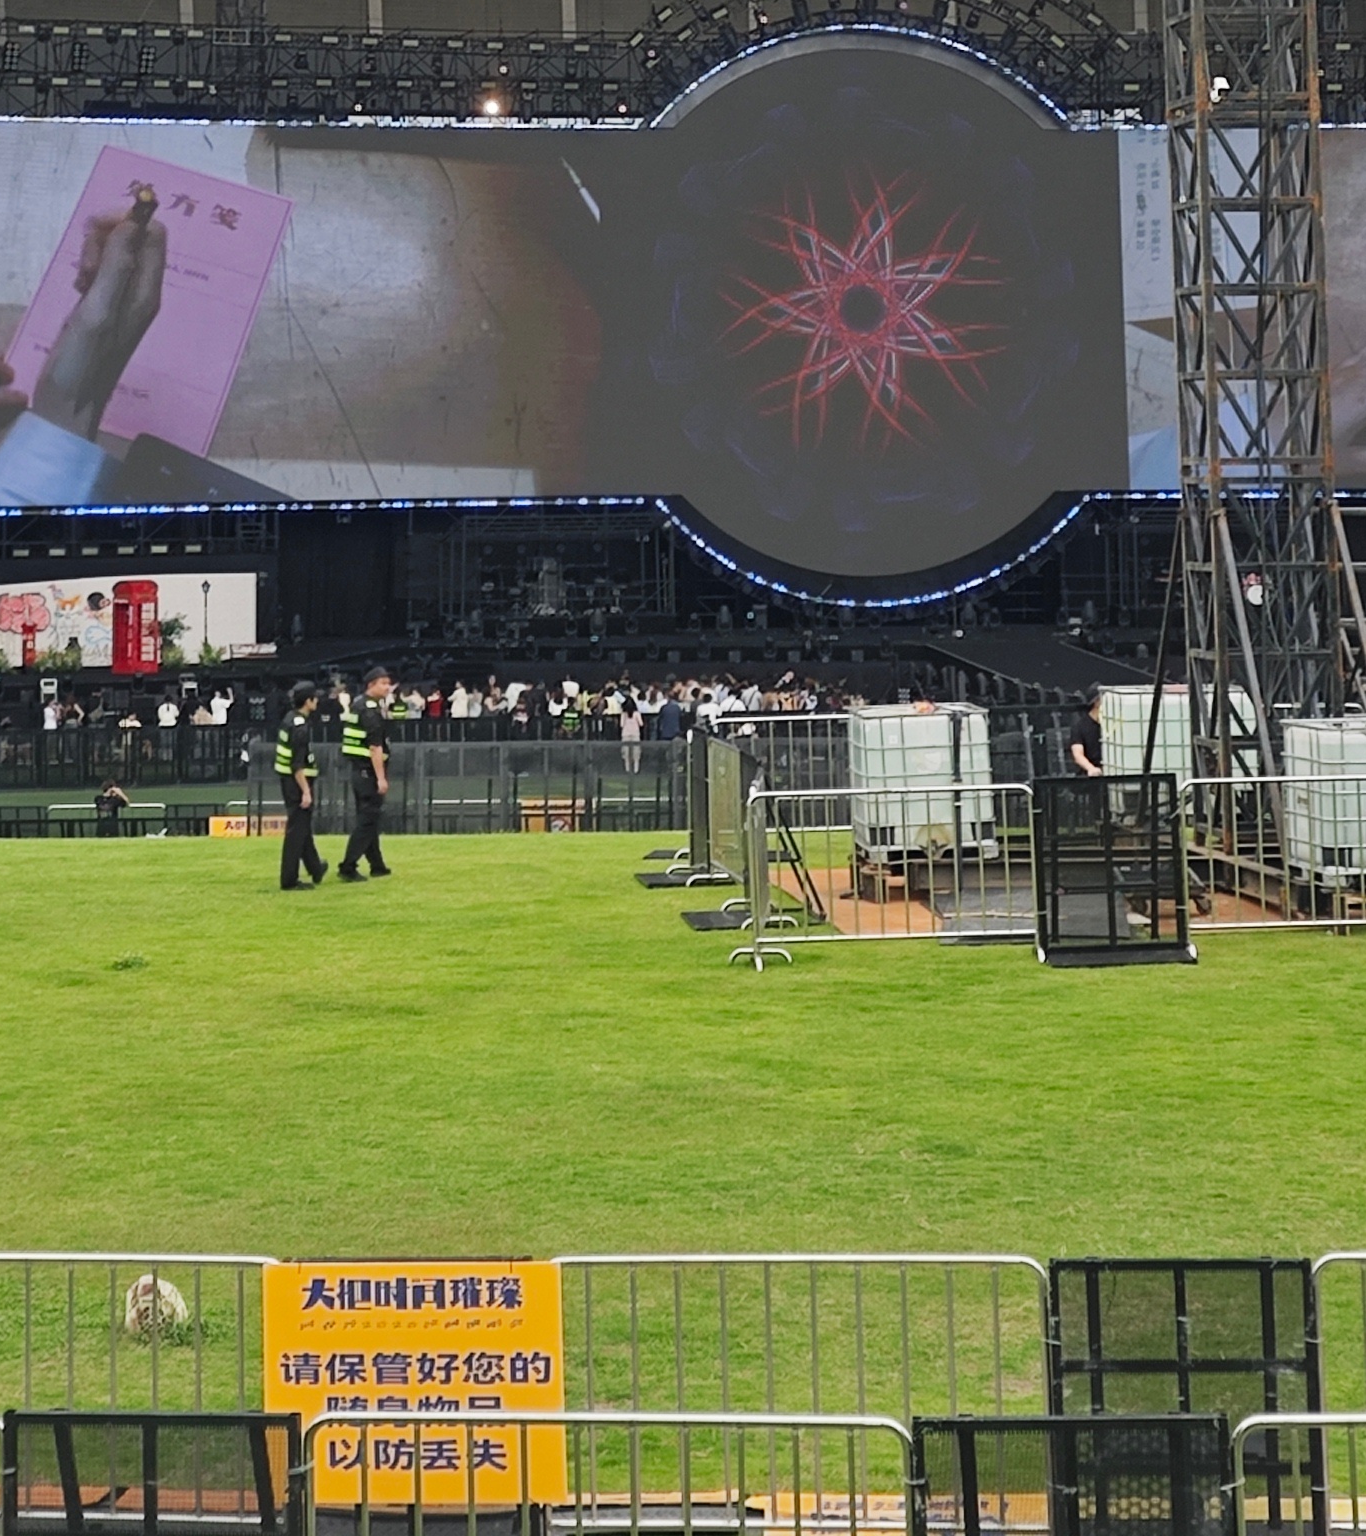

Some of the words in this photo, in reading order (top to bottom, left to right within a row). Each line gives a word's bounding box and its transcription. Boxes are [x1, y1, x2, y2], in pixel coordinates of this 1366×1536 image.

[301, 1277, 523, 1310] 大把时间璀璨
[280, 1351, 552, 1385] 请保管好您的
[328, 1438, 508, 1471] 以防丢失
